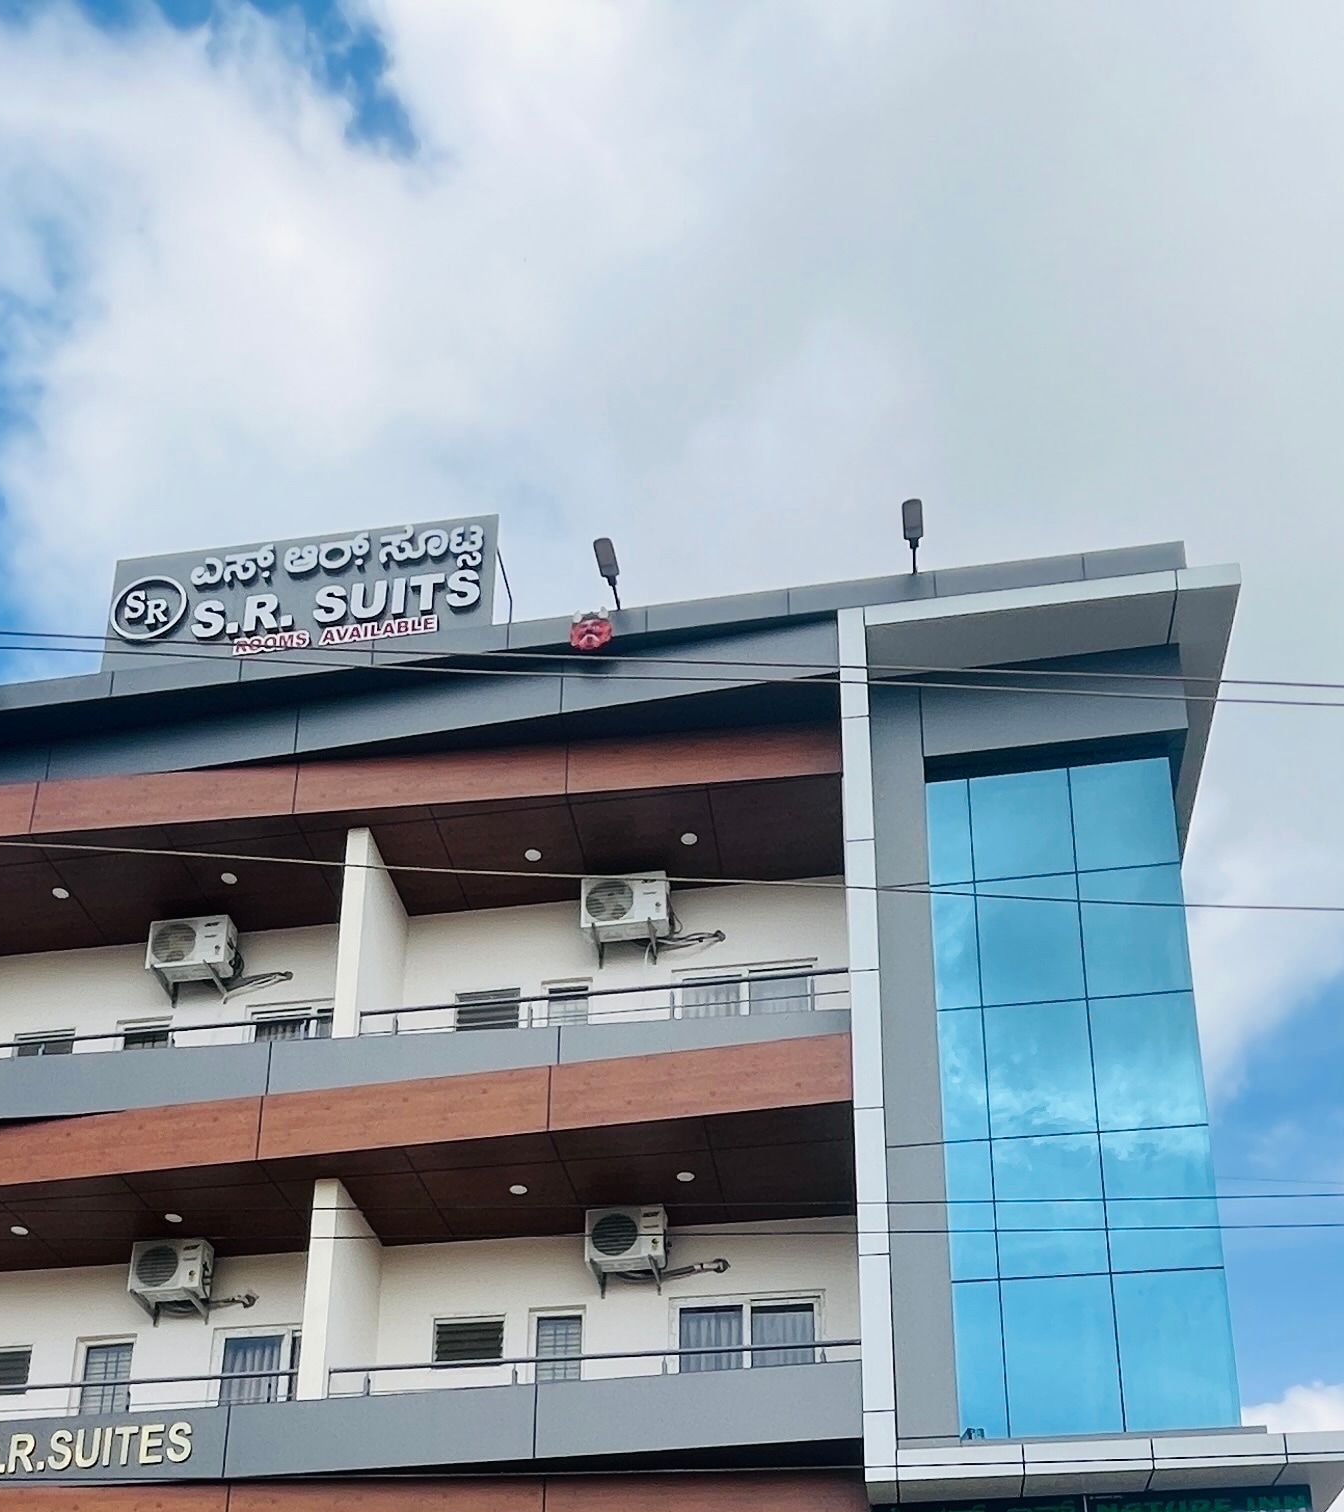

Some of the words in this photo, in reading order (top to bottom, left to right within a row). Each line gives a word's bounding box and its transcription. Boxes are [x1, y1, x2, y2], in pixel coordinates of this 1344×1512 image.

[124, 590, 168, 625] SR
[190, 593, 293, 638] S.R.
[313, 570, 481, 623] SUITS
[233, 630, 311, 655] ROOMS
[318, 615, 439, 645] AVAILABLE
